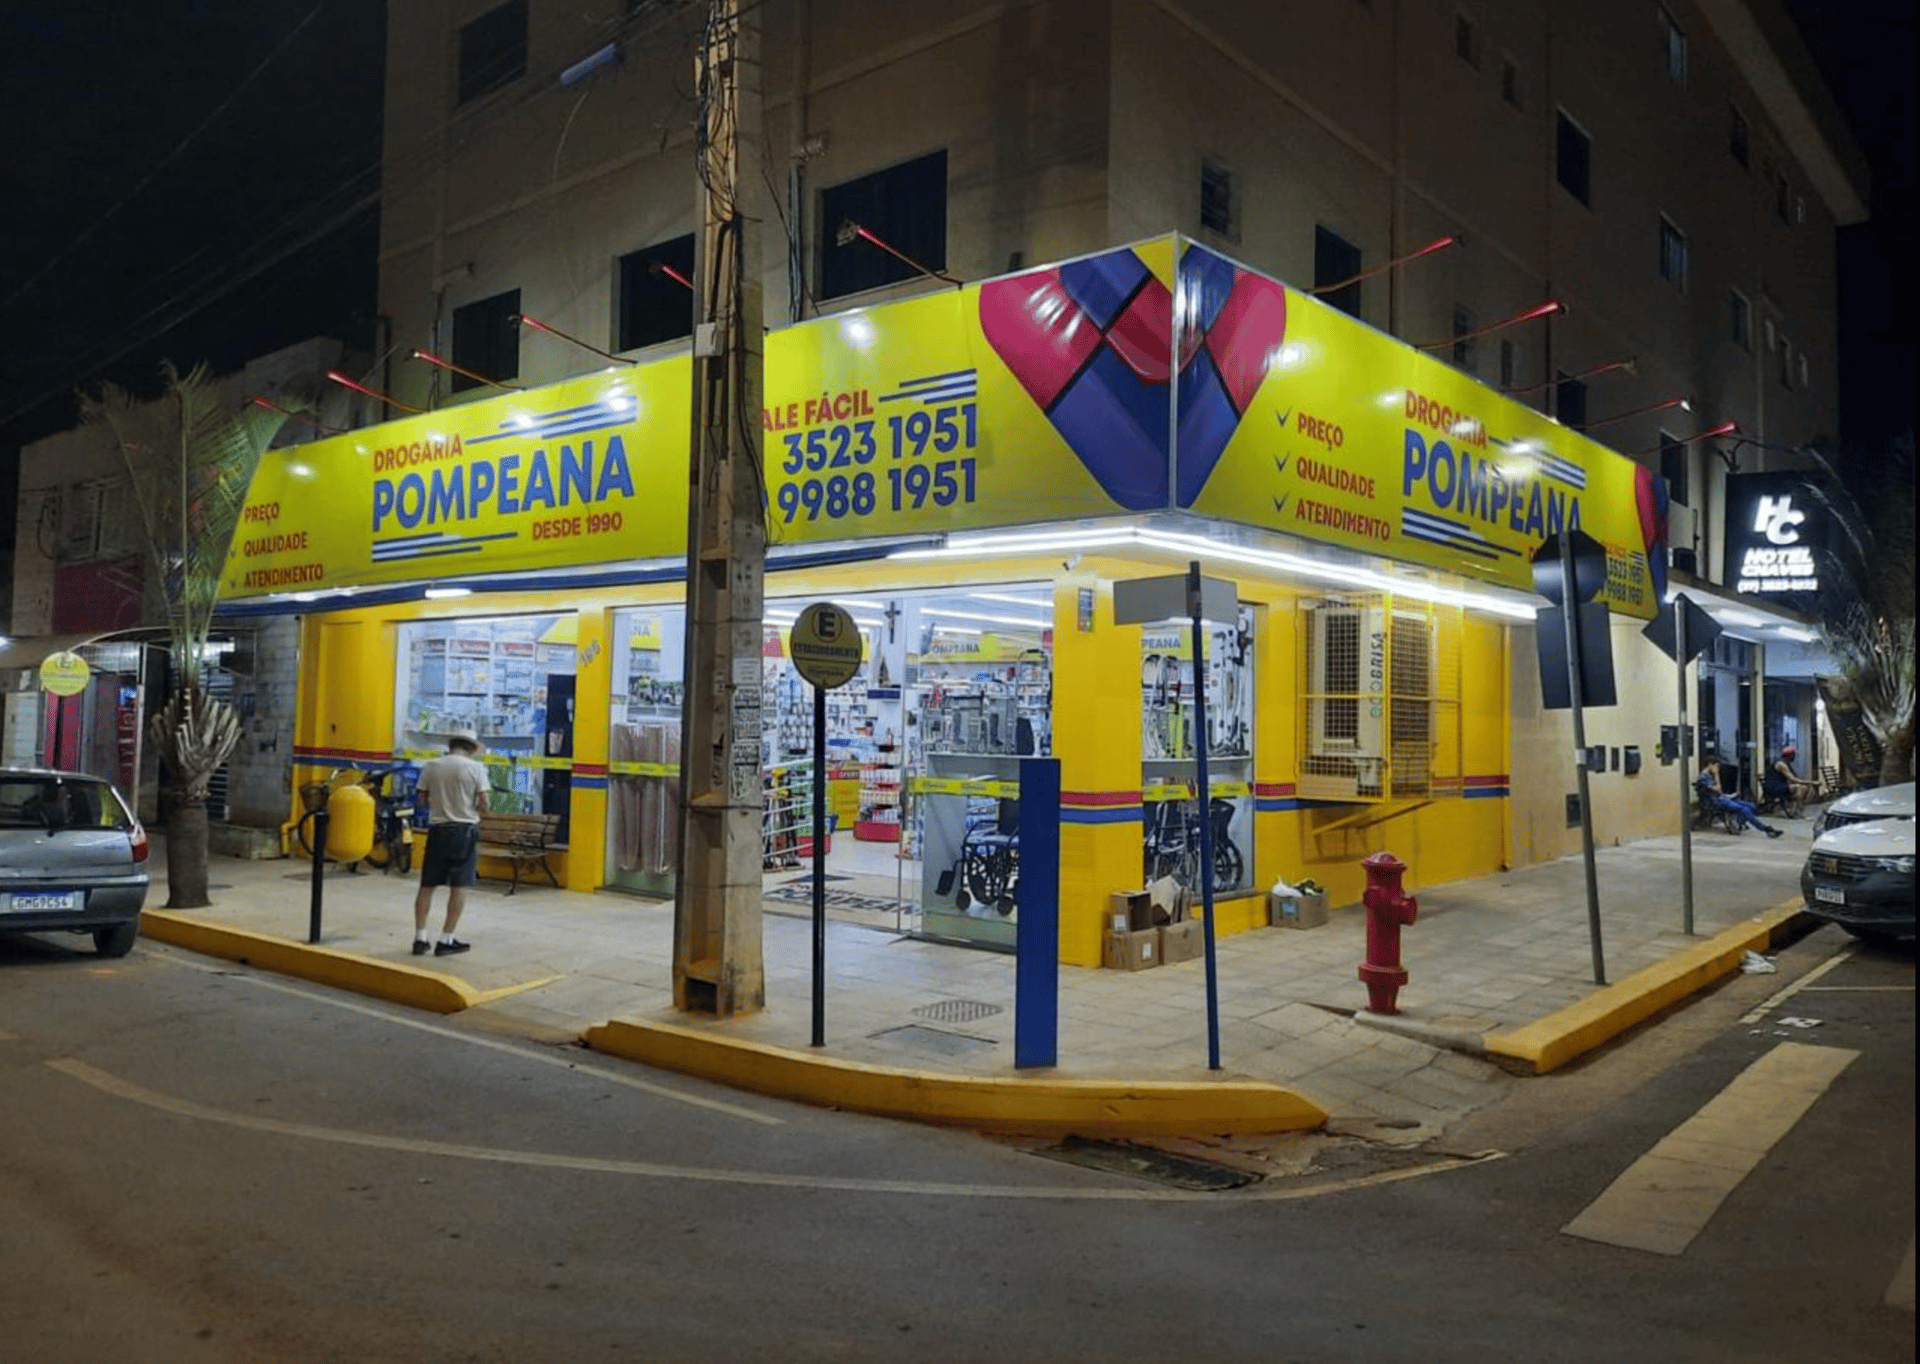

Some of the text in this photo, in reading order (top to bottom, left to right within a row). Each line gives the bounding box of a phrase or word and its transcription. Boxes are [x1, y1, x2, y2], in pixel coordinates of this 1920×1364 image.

[761, 389, 874, 432] ALE FÁCIL
[783, 403, 976, 475] 3523 1951
[1297, 412, 1343, 450] PREÇO
[373, 434, 463, 472] DROGARIA
[372, 435, 635, 532] POMPEANA
[778, 472, 876, 523] 9988
[888, 457, 976, 512] 1951
[1296, 456, 1375, 499] QUALIDADE
[1403, 428, 1581, 540] POMPEANA
[244, 502, 280, 525] PREÇO
[532, 511, 622, 541] DESDE 1990
[1295, 498, 1391, 541] ATENDIMENTO
[243, 532, 308, 557] QUALIDADE
[243, 564, 324, 588] ATENDIMENTO
[819, 612, 836, 637] E
